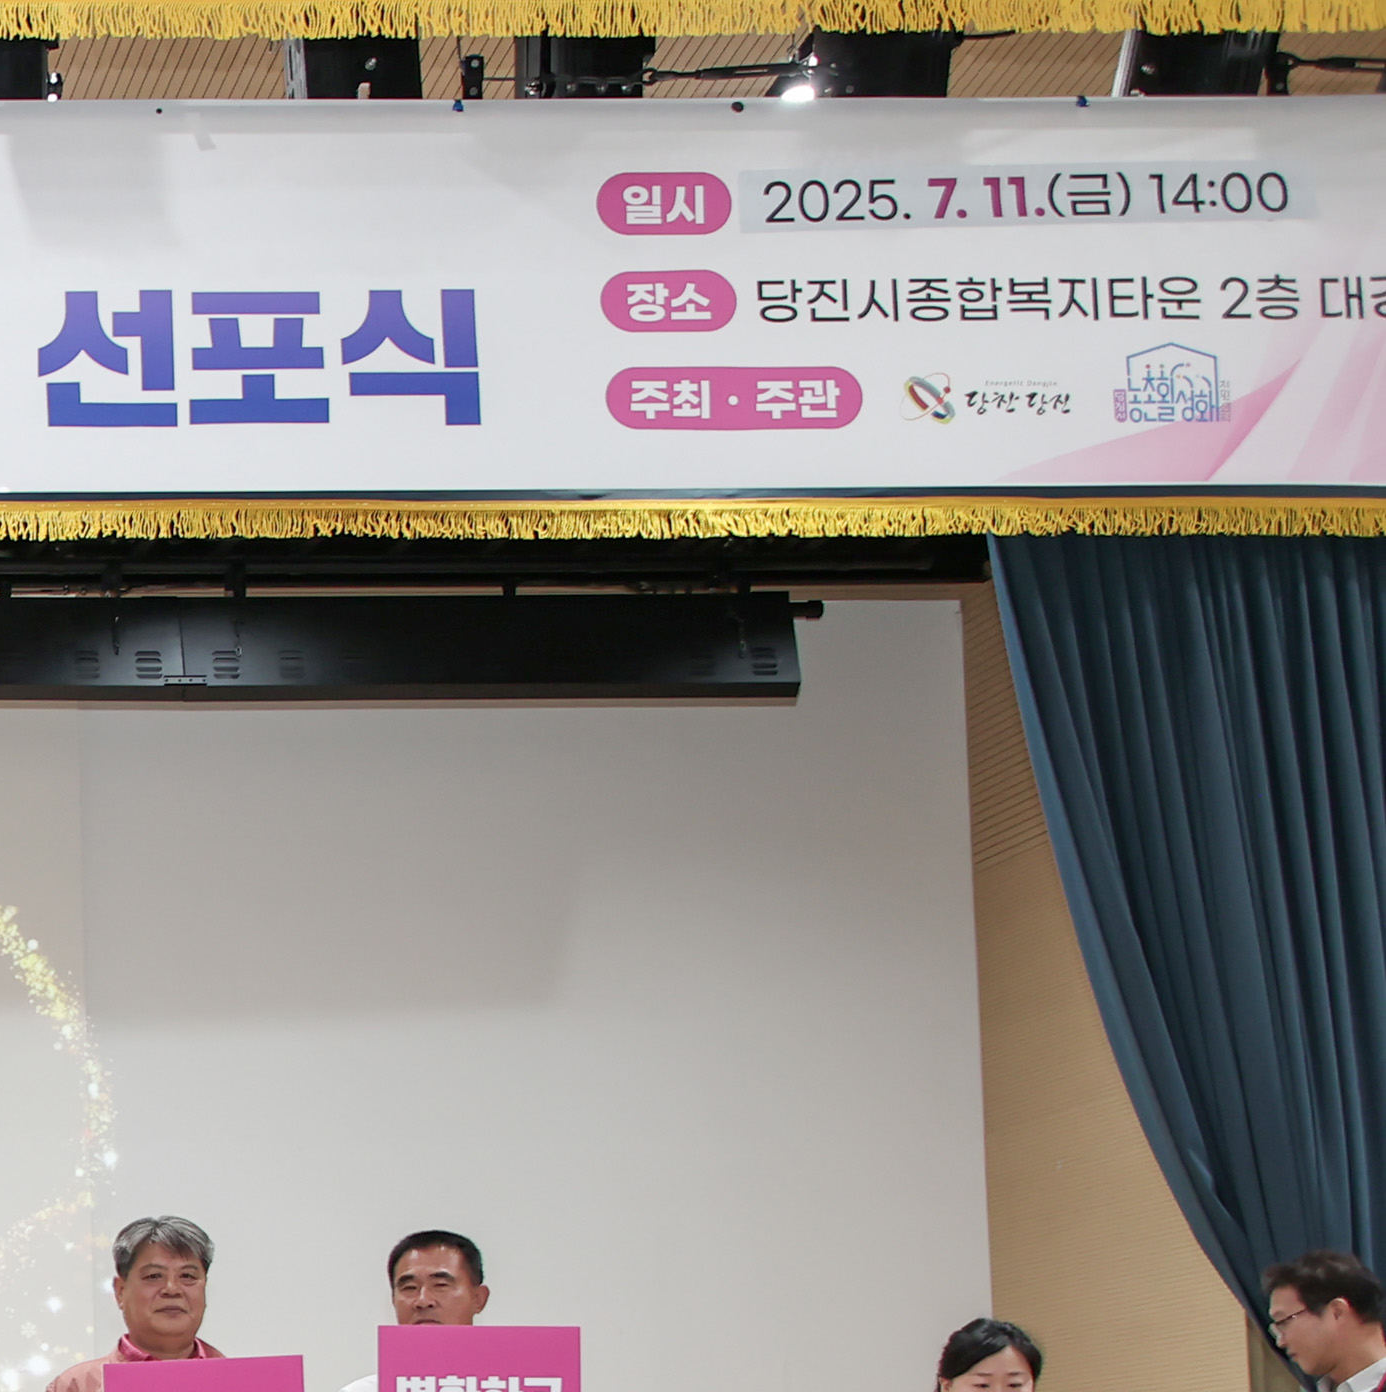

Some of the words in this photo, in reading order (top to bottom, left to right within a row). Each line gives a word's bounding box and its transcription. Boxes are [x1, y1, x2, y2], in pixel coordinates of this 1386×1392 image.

[622, 184, 706, 226] 일시
[763, 178, 911, 223] 2025.
[1148, 171, 1289, 214] 14:00
[625, 282, 713, 322] 장소
[756, 276, 1202, 323] 당진시종합복지타운
[1220, 273, 1300, 321] 2층
[38, 288, 482, 427] 선포식
